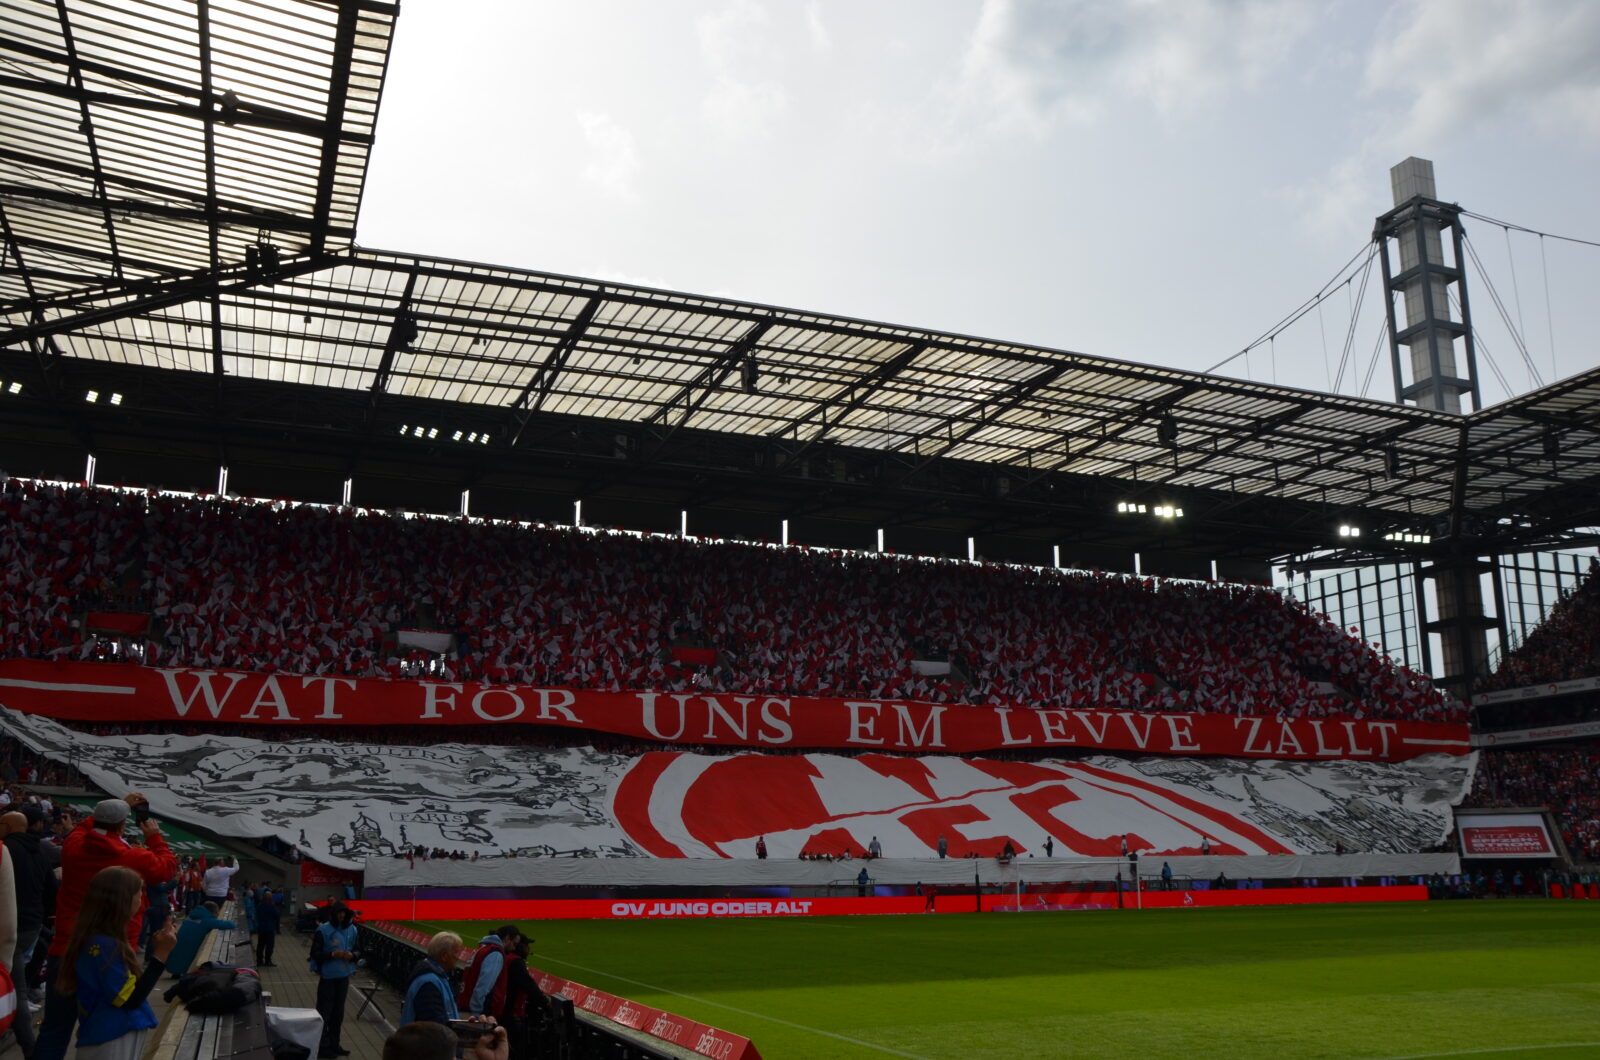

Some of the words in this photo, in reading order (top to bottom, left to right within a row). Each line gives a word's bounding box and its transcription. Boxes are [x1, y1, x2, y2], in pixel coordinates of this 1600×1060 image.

[156, 668, 358, 721] WAT
[418, 682, 584, 724] FÖR
[636, 692, 794, 744] UNS
[844, 702, 948, 748] EM
[993, 707, 1202, 751] LEVVE
[1233, 715, 1398, 758] ZÄLLT
[232, 747, 256, 761] 15
[260, 745, 355, 756] JAHRE
[365, 746, 473, 765] ULTRAS
[399, 812, 464, 823] PARIS
[611, 903, 646, 916] OV
[647, 903, 709, 915] JUNG
[711, 903, 773, 915] ODER
[774, 901, 812, 914] ALT
